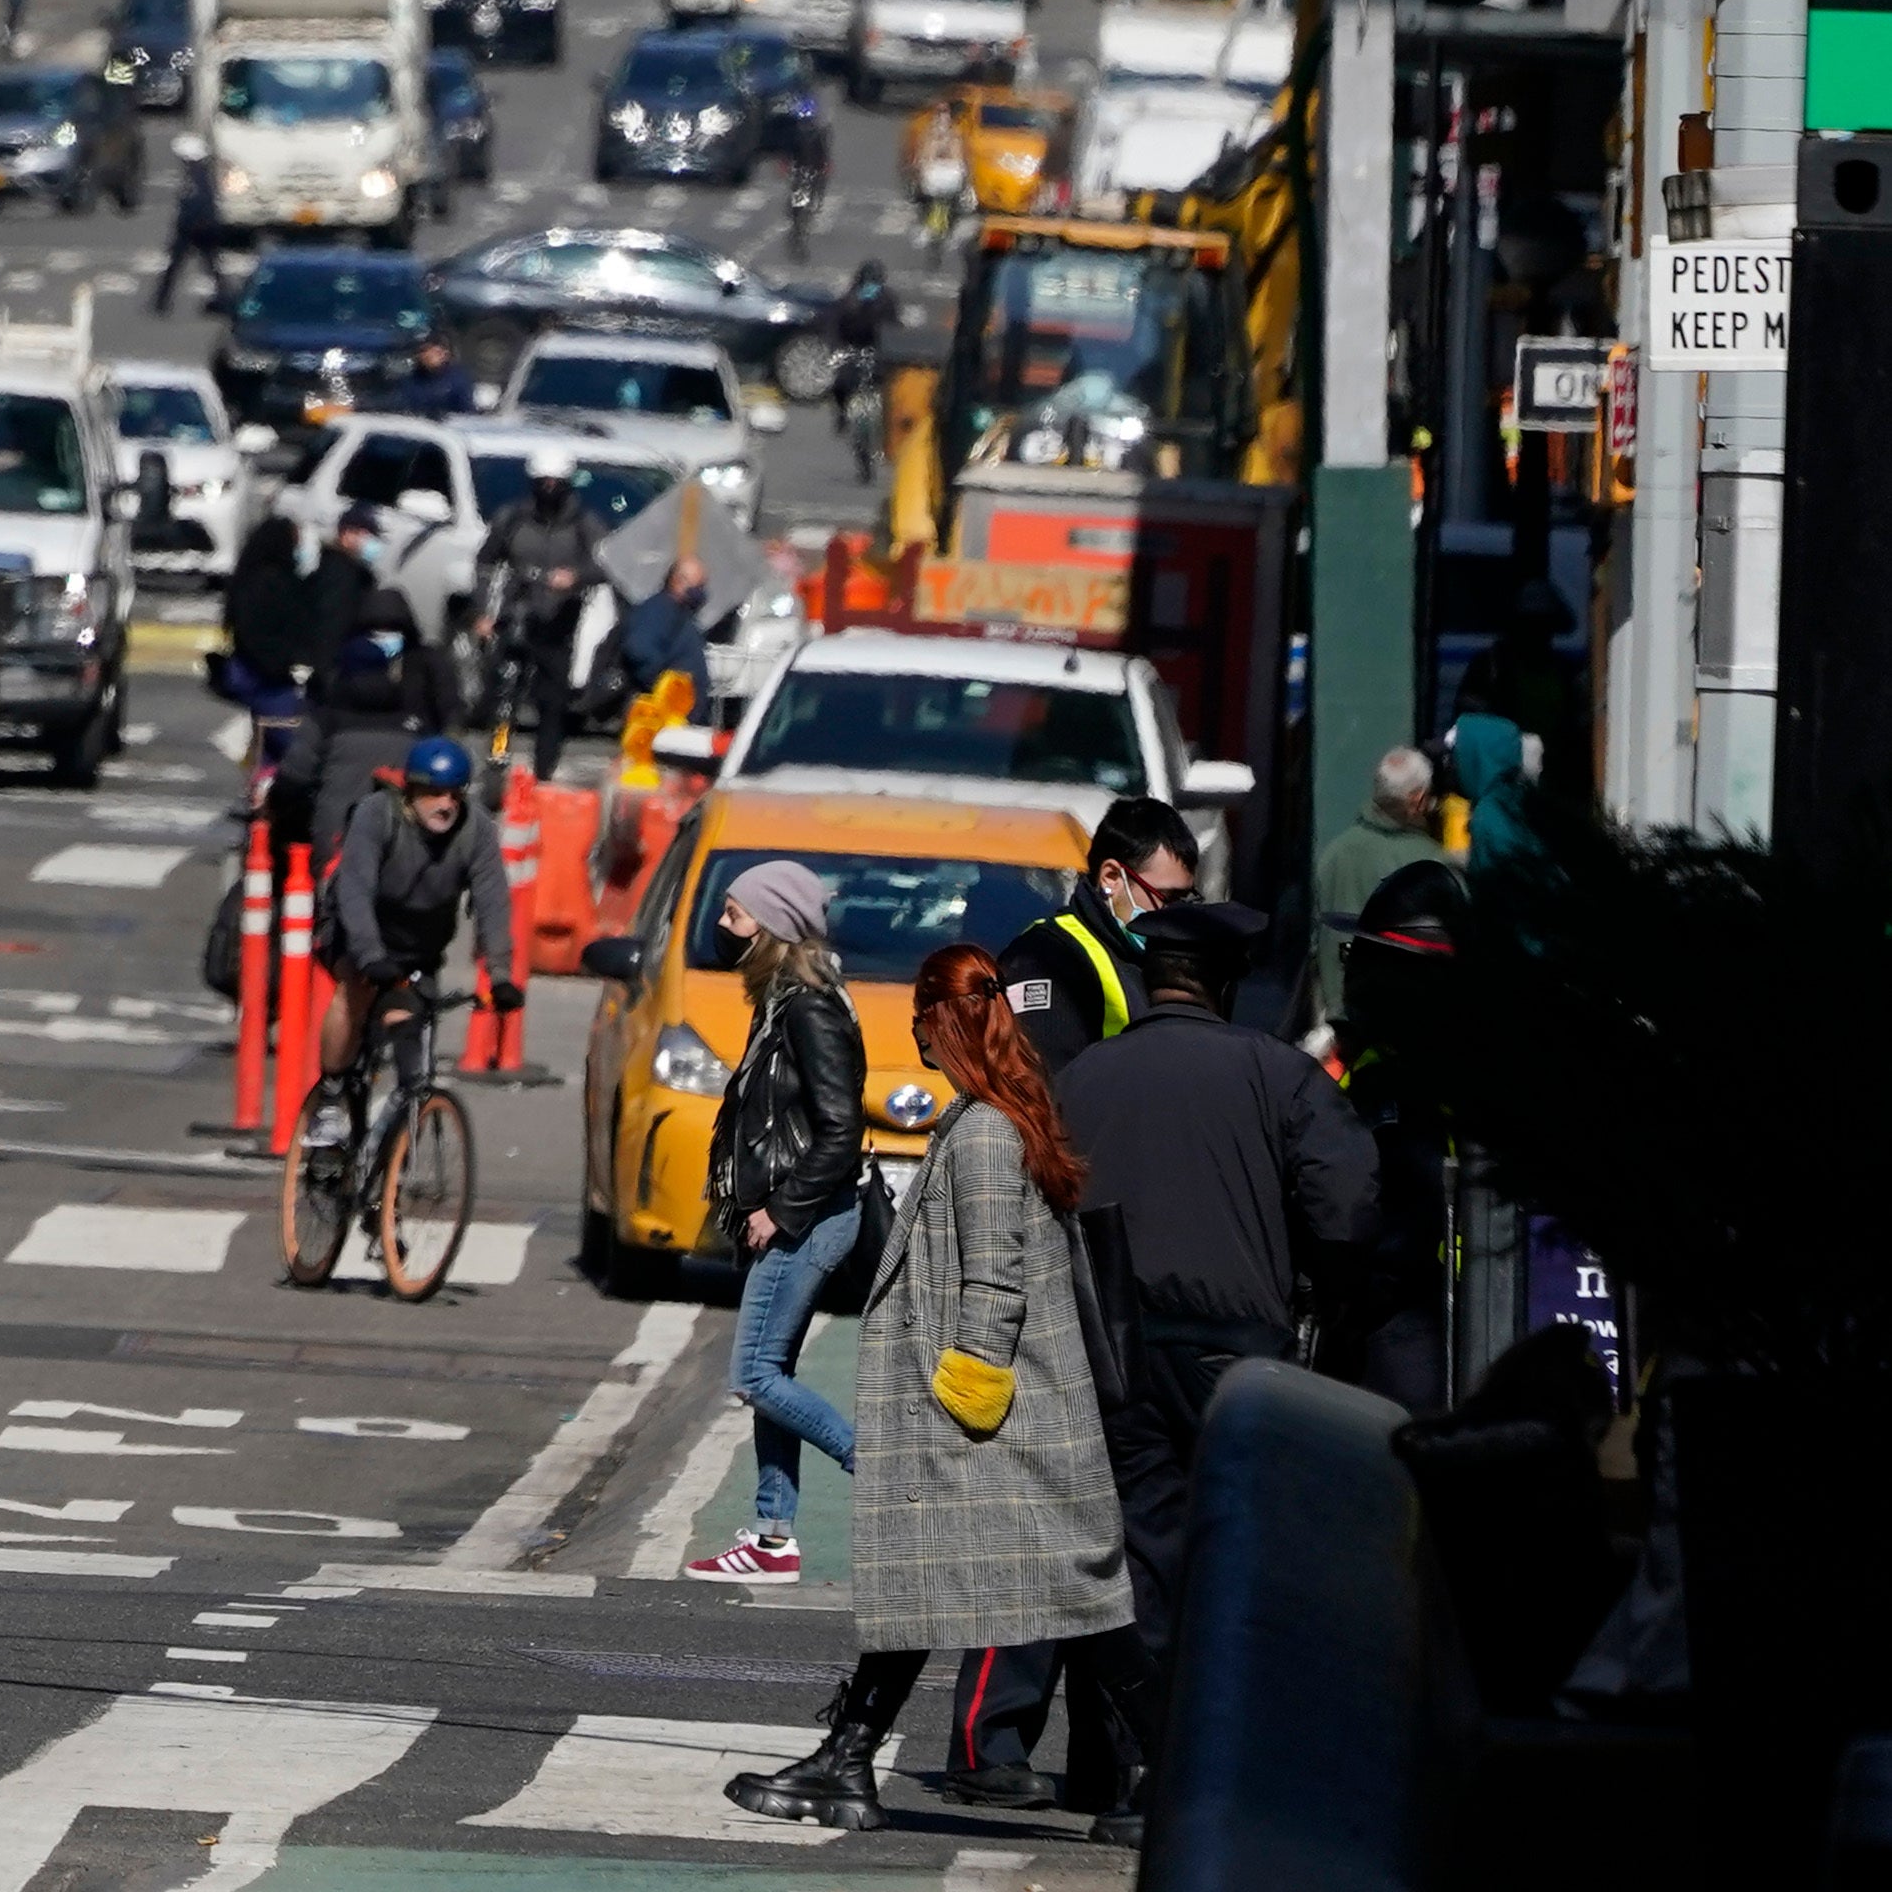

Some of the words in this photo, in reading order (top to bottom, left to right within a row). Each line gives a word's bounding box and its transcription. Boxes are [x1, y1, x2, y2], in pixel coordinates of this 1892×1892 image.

[1672, 256, 1793, 293] PEDEST
[1672, 311, 1748, 349] KEEP
[1555, 371, 1601, 405] ON
